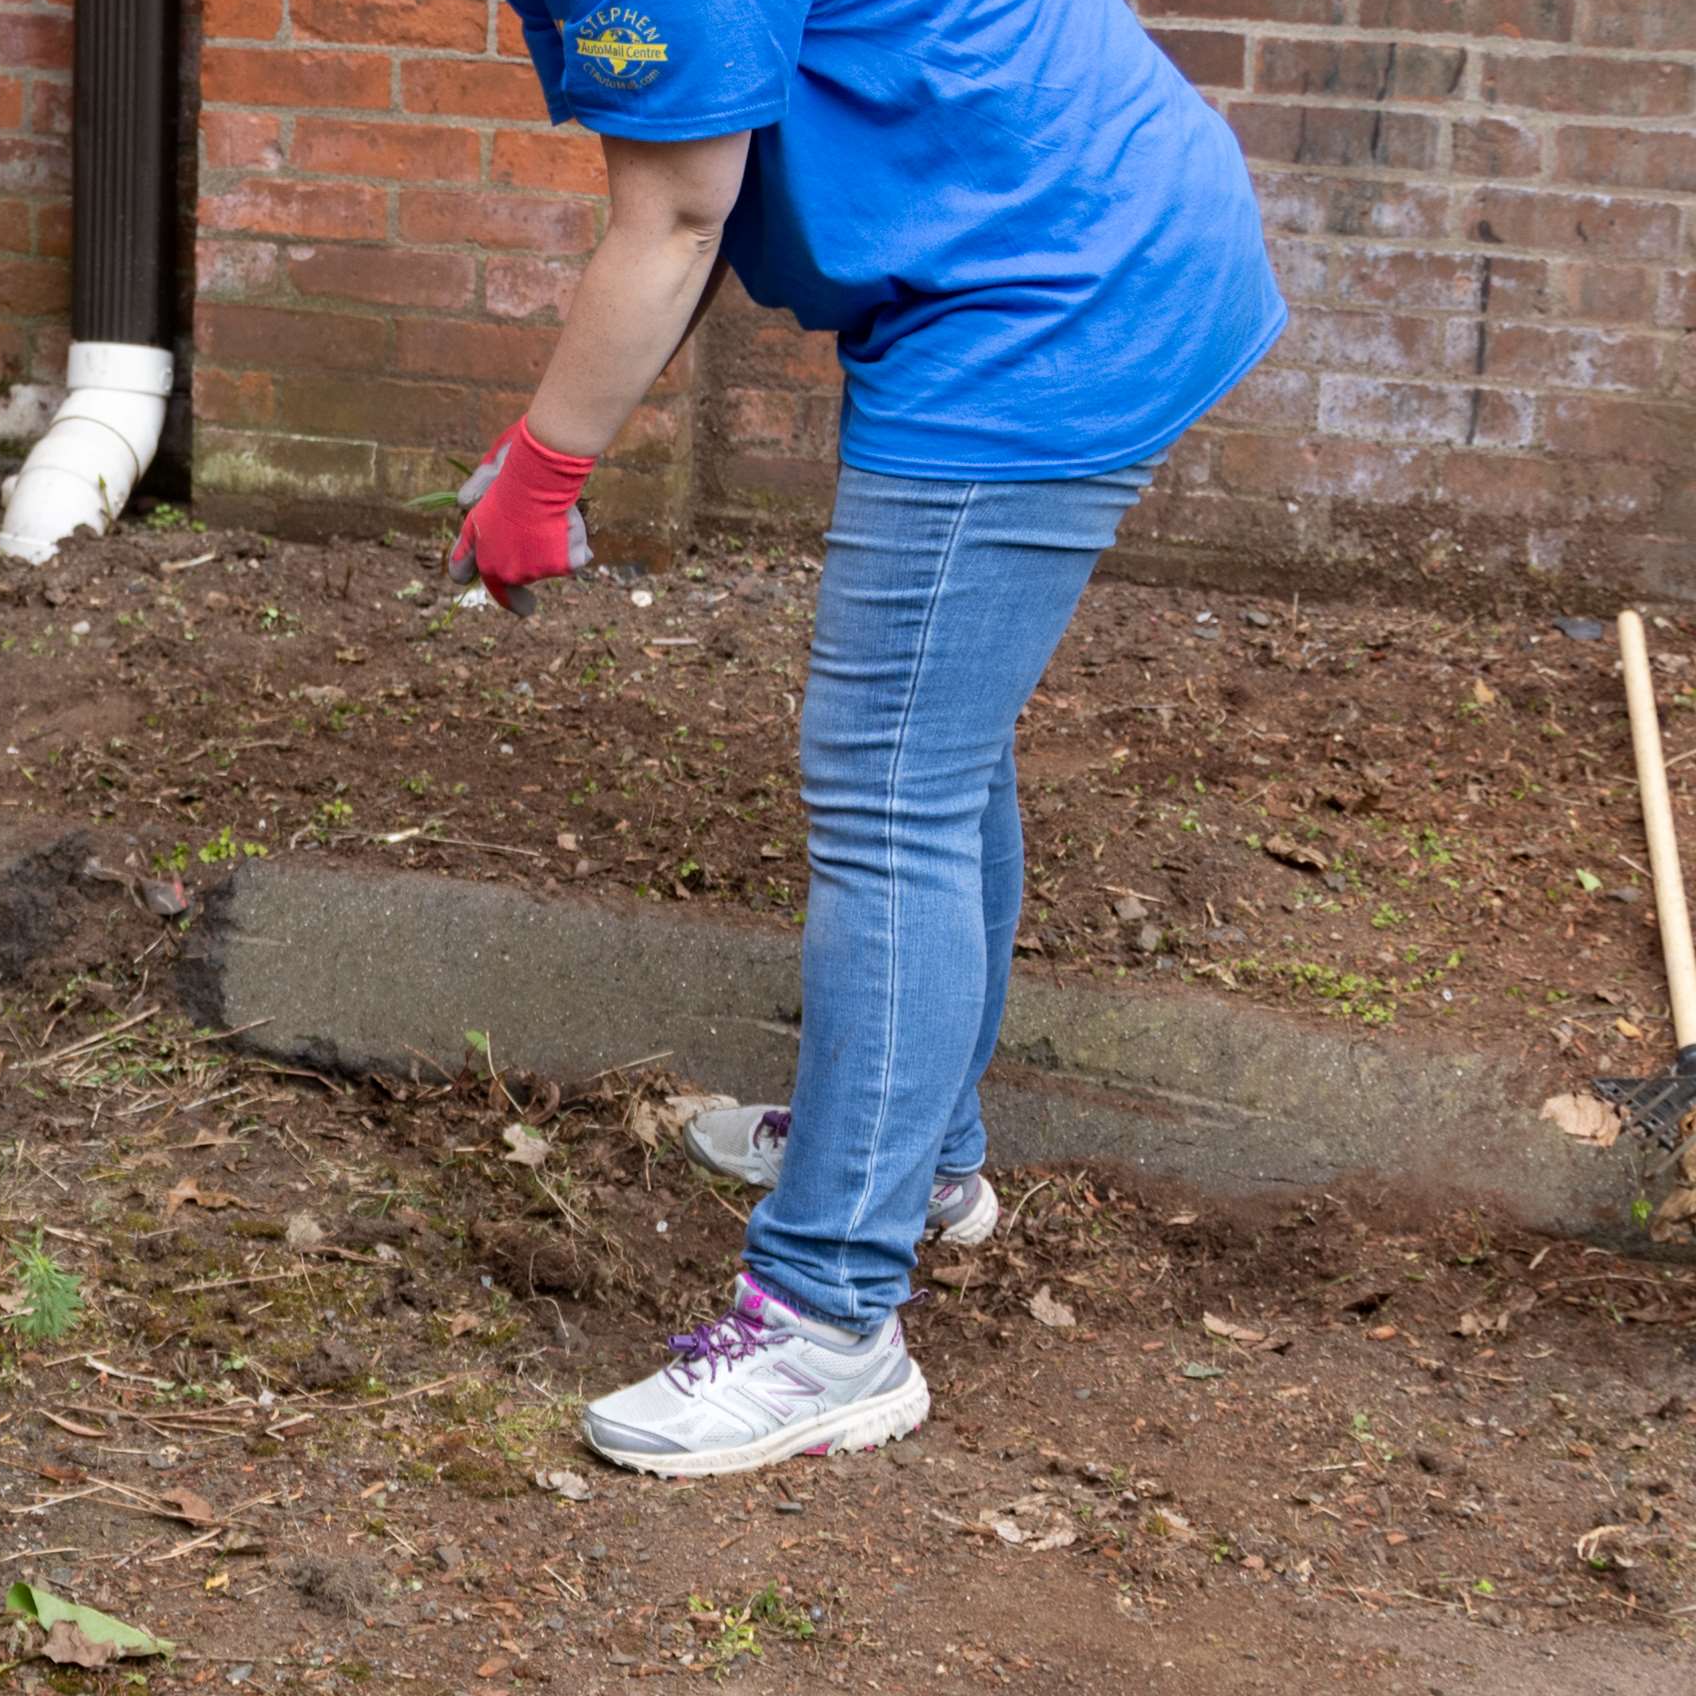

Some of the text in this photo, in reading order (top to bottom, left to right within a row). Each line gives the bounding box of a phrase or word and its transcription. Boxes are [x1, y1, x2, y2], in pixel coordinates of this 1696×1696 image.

[579, 7, 661, 43] STEPHEN
[581, 42, 662, 59] AutoMall Centre
